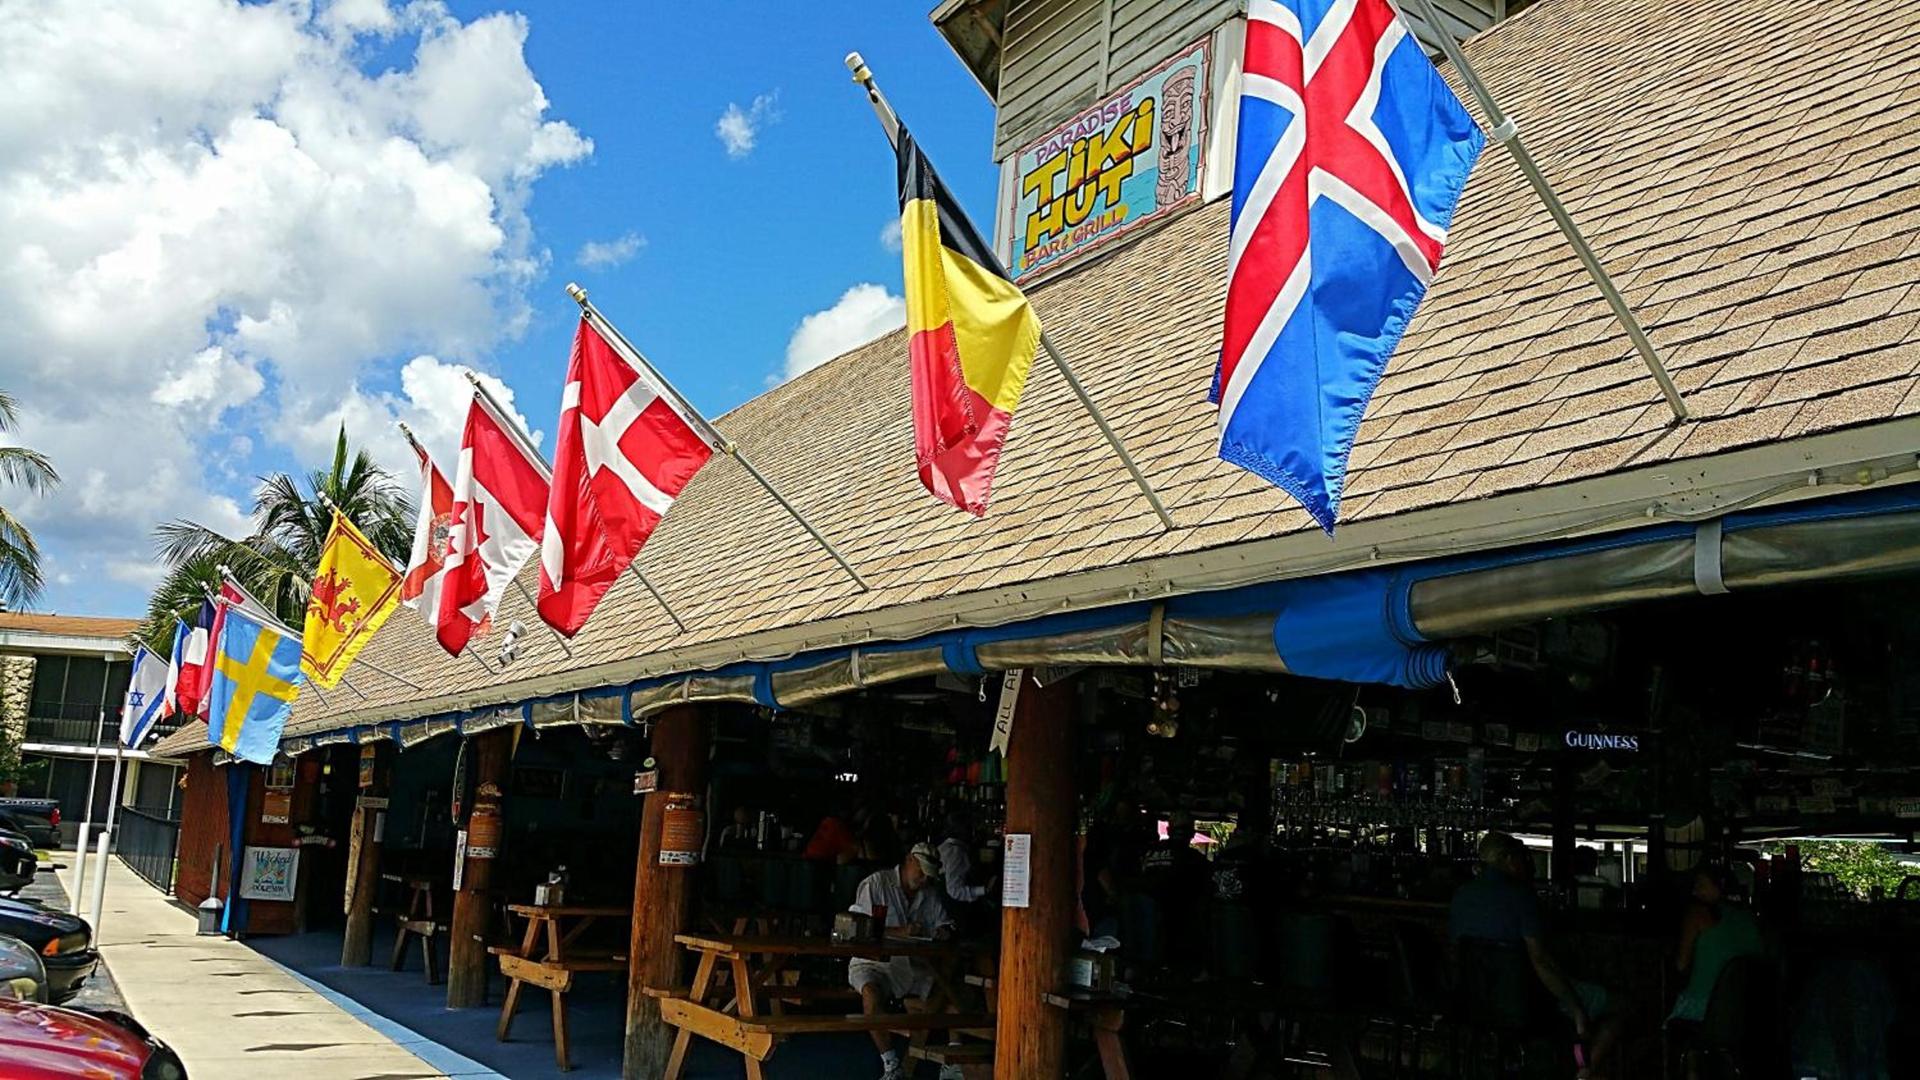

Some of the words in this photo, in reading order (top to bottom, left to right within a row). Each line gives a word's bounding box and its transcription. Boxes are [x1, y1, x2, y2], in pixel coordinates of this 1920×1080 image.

[1035, 94, 1133, 166] PARADISE
[1024, 159, 1134, 253] HUT
[1024, 241, 1062, 268] BAR
[1071, 211, 1123, 243] GRILL
[996, 702, 1012, 735] ALL
[1565, 730, 1639, 750] GUINNESS
